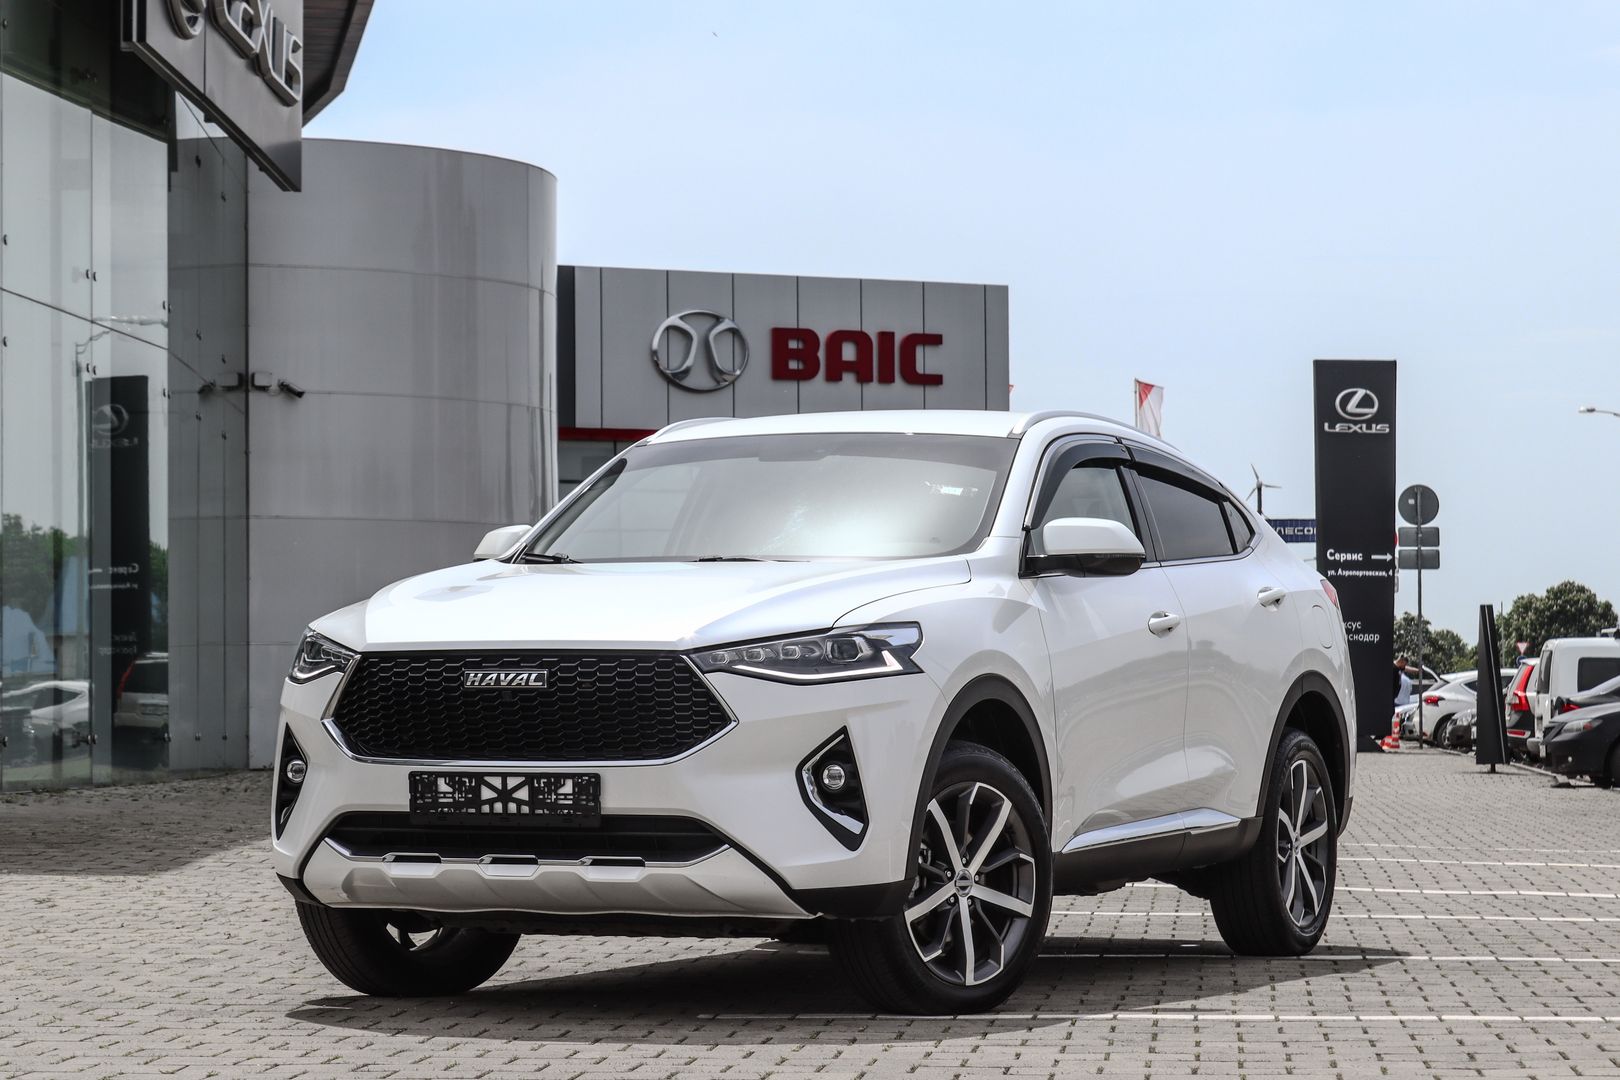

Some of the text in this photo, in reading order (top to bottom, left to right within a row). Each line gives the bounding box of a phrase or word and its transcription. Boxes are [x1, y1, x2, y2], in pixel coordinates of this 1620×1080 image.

[770, 327, 943, 386] BAIC
[1324, 422, 1390, 433] LEXUS
[1273, 526, 1316, 535] ЛЕСО
[1326, 549, 1363, 562] Сервис
[1343, 621, 1362, 631] ксус
[1346, 633, 1380, 643] снодар
[466, 673, 543, 686] HAVAL
